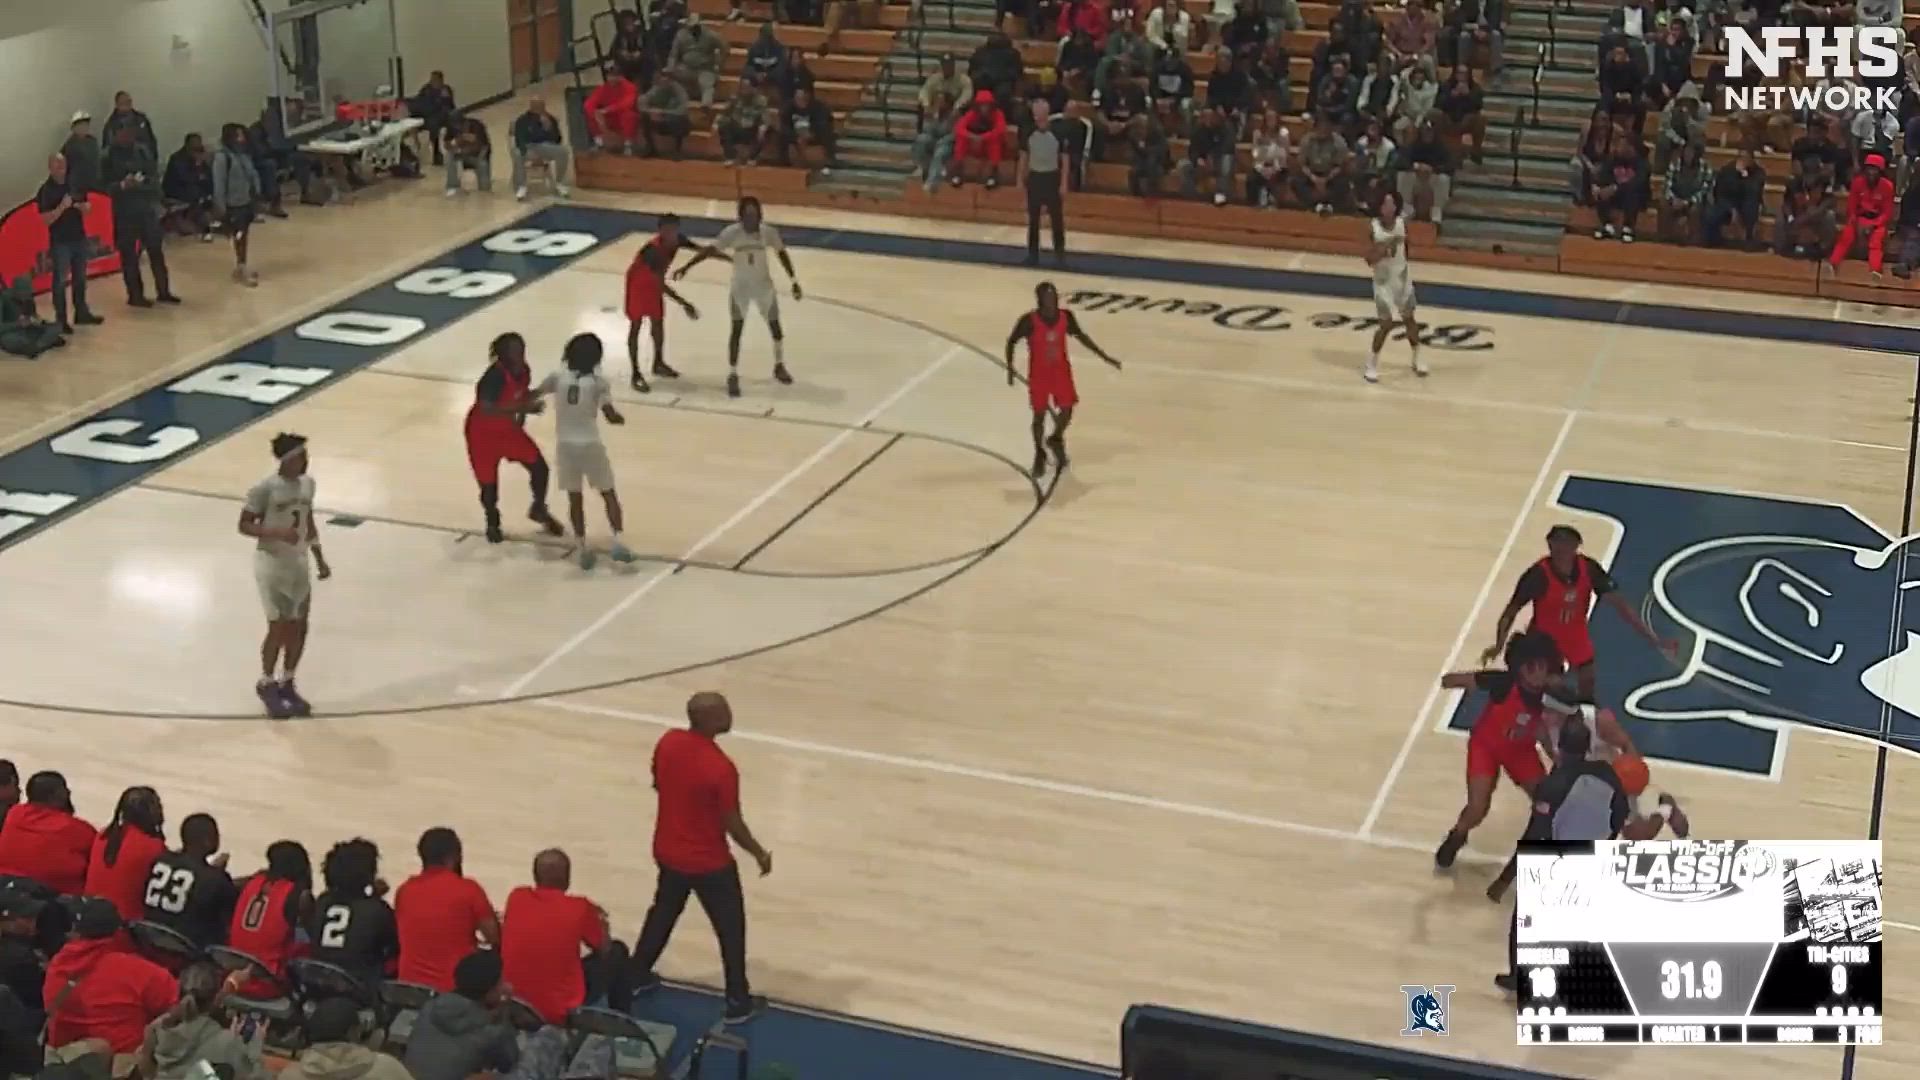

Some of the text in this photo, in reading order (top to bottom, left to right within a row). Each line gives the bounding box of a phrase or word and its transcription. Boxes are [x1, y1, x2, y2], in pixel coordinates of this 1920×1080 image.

[145, 861, 195, 913] 23
[241, 895, 269, 932] 0
[321, 904, 350, 948] 2
